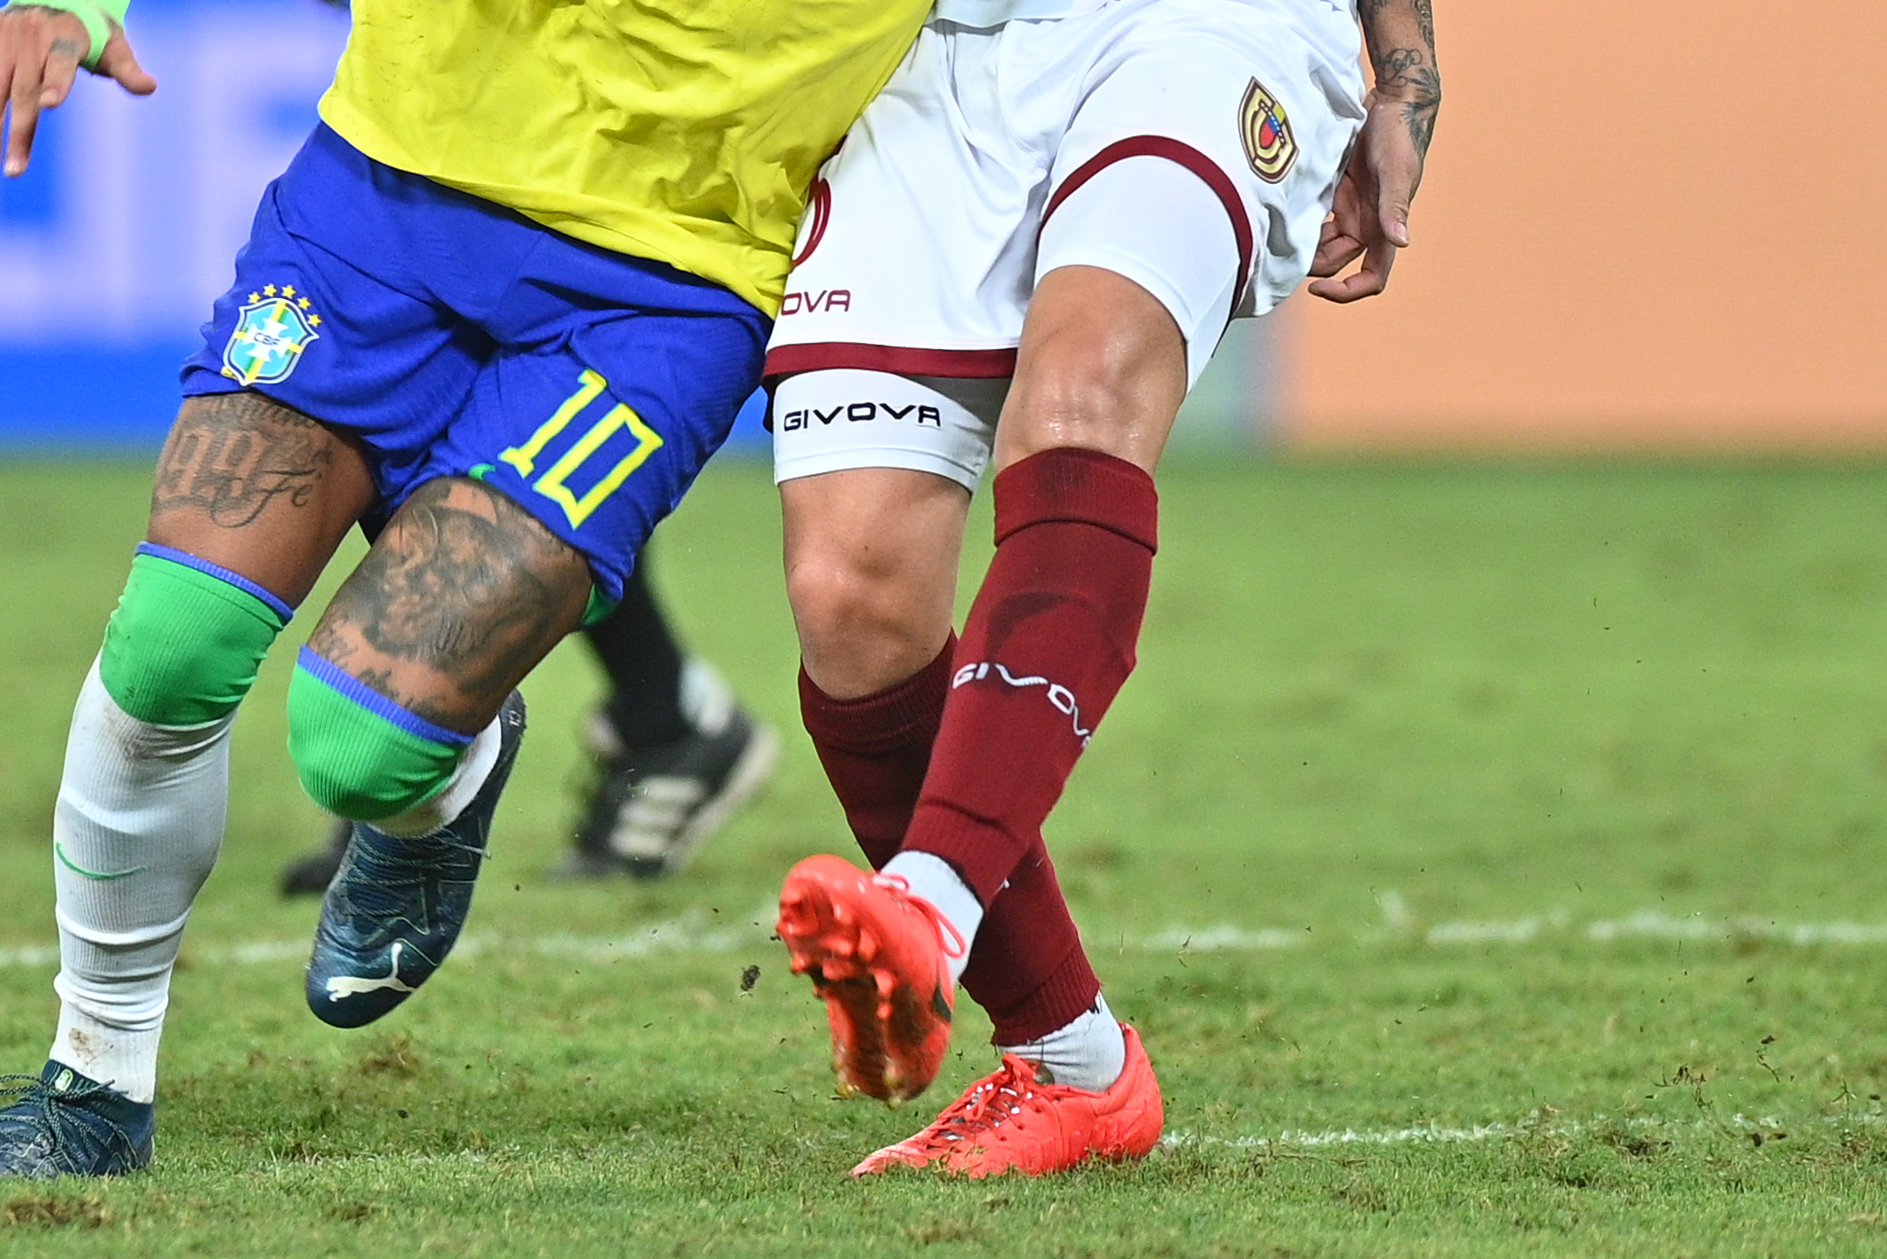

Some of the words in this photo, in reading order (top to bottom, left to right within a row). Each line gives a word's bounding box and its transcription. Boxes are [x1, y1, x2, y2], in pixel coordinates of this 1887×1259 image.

[781, 289, 851, 316] OVA
[783, 402, 941, 432] GIVOVA
[498, 368, 664, 532] 10
